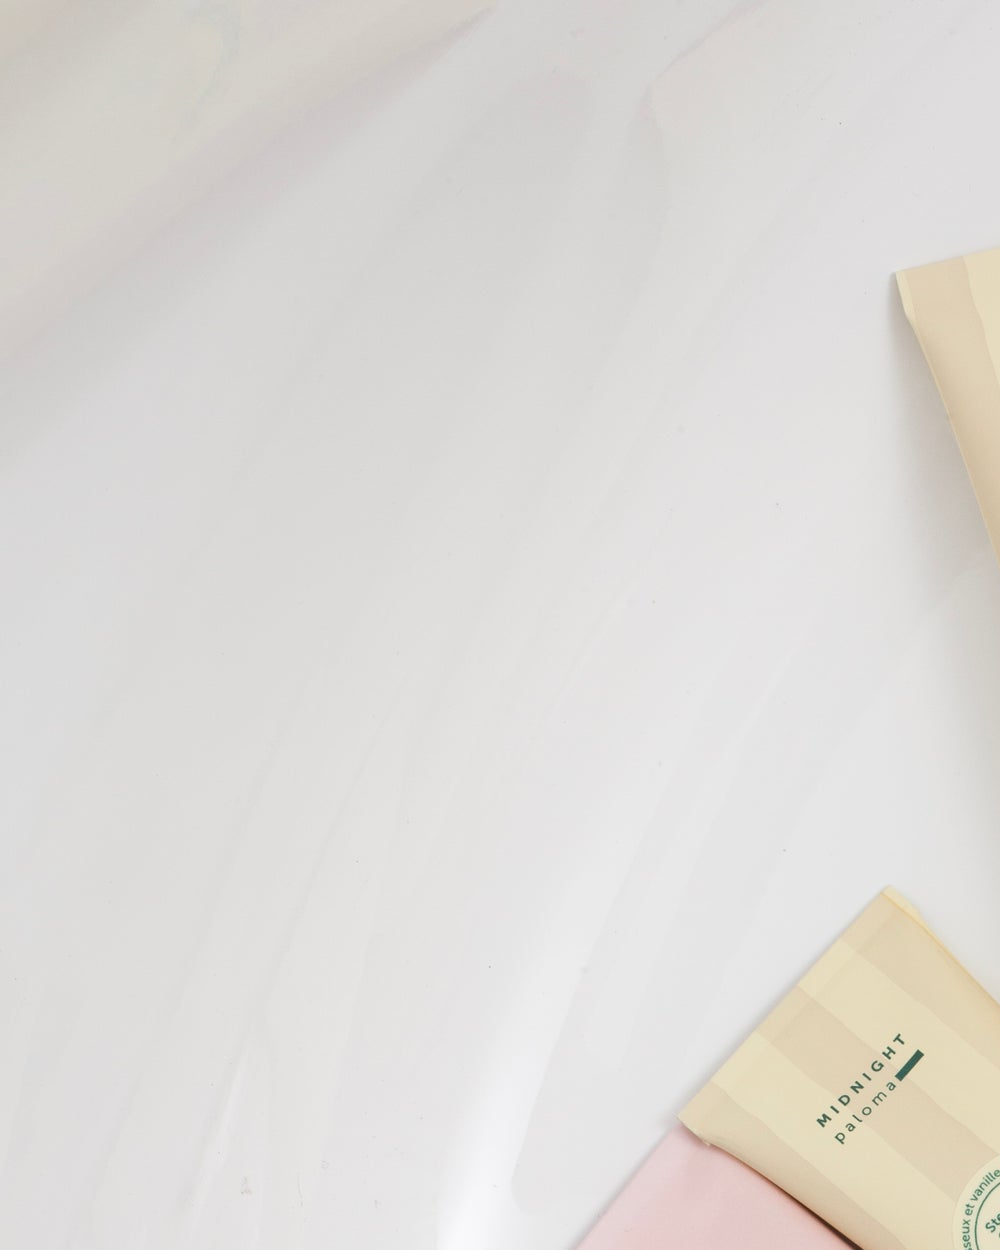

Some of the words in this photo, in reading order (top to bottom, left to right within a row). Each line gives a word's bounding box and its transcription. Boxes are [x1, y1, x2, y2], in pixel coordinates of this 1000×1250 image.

[816, 1033, 905, 1128] MIDNIGHT
[835, 1081, 896, 1144] paloma
[965, 1204, 974, 1216] et
